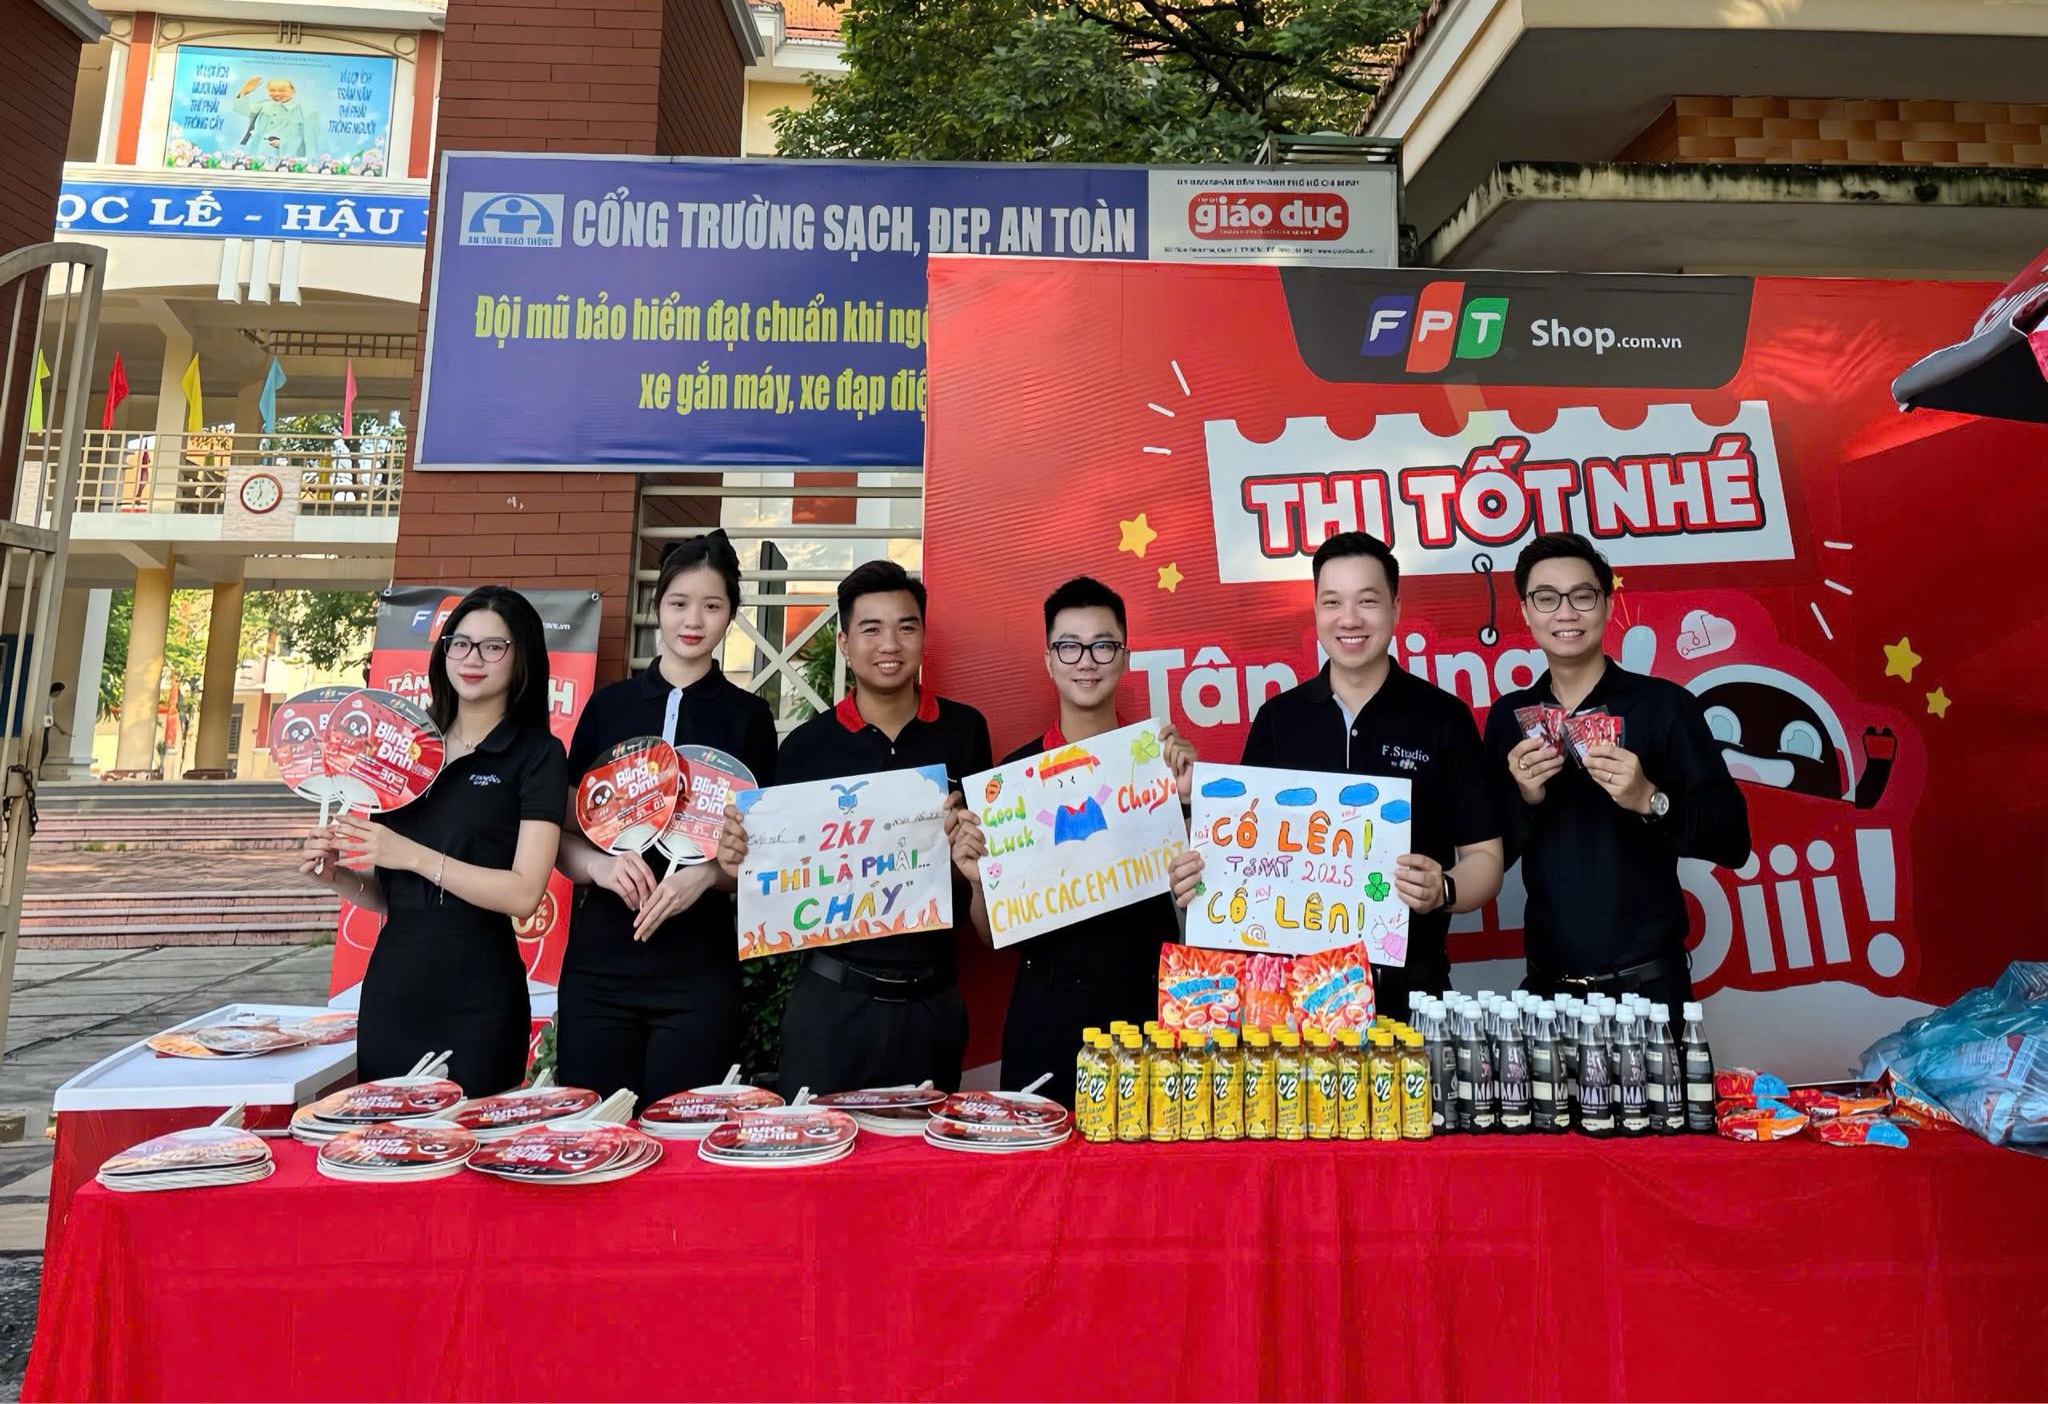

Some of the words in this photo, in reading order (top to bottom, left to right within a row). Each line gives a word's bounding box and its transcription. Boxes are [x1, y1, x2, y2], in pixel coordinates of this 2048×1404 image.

[57, 195, 128, 228] ỌC
[149, 190, 223, 227] LỄ
[282, 199, 403, 237] HẬU
[573, 187, 668, 248] CỔNG
[678, 195, 815, 251] TRƯỜNG
[824, 204, 920, 261] SẠCH,
[1000, 207, 1043, 253] AN
[1051, 199, 1135, 254] TOÀN
[1195, 196, 1273, 233] giáo
[1280, 200, 1343, 235] dục
[475, 295, 520, 349] Đội
[527, 294, 570, 341] mũ
[576, 292, 626, 341] bảo
[633, 291, 700, 342] hiểm
[707, 299, 749, 351] đạt
[756, 294, 837, 343] chuẩn
[843, 301, 884, 343] khi
[639, 374, 671, 410] xe
[677, 361, 727, 416] gắn
[734, 366, 794, 415] máy,
[800, 375, 830, 411] xe
[836, 368, 886, 420] đạp
[1242, 470, 1394, 557] THI
[1400, 436, 1579, 547] TỐT
[1587, 433, 1765, 537] NHÉ
[1382, 744, 1430, 763] F.Studio
[983, 795, 1026, 829] Good
[1212, 798, 1259, 848] CỐ
[987, 826, 1035, 857] Luck
[1301, 861, 1353, 887] 2025
[991, 882, 1043, 933] CHÚC
[1044, 868, 1084, 916] CÁC
[1086, 864, 1119, 904] EM
[1207, 879, 1249, 924] CỐ
[1089, 1076, 1107, 1103] C2
[1278, 1073, 1298, 1100] C2
[1340, 1073, 1358, 1101] C2
[1374, 1075, 1392, 1102] C2
[1405, 1073, 1425, 1099] C2
